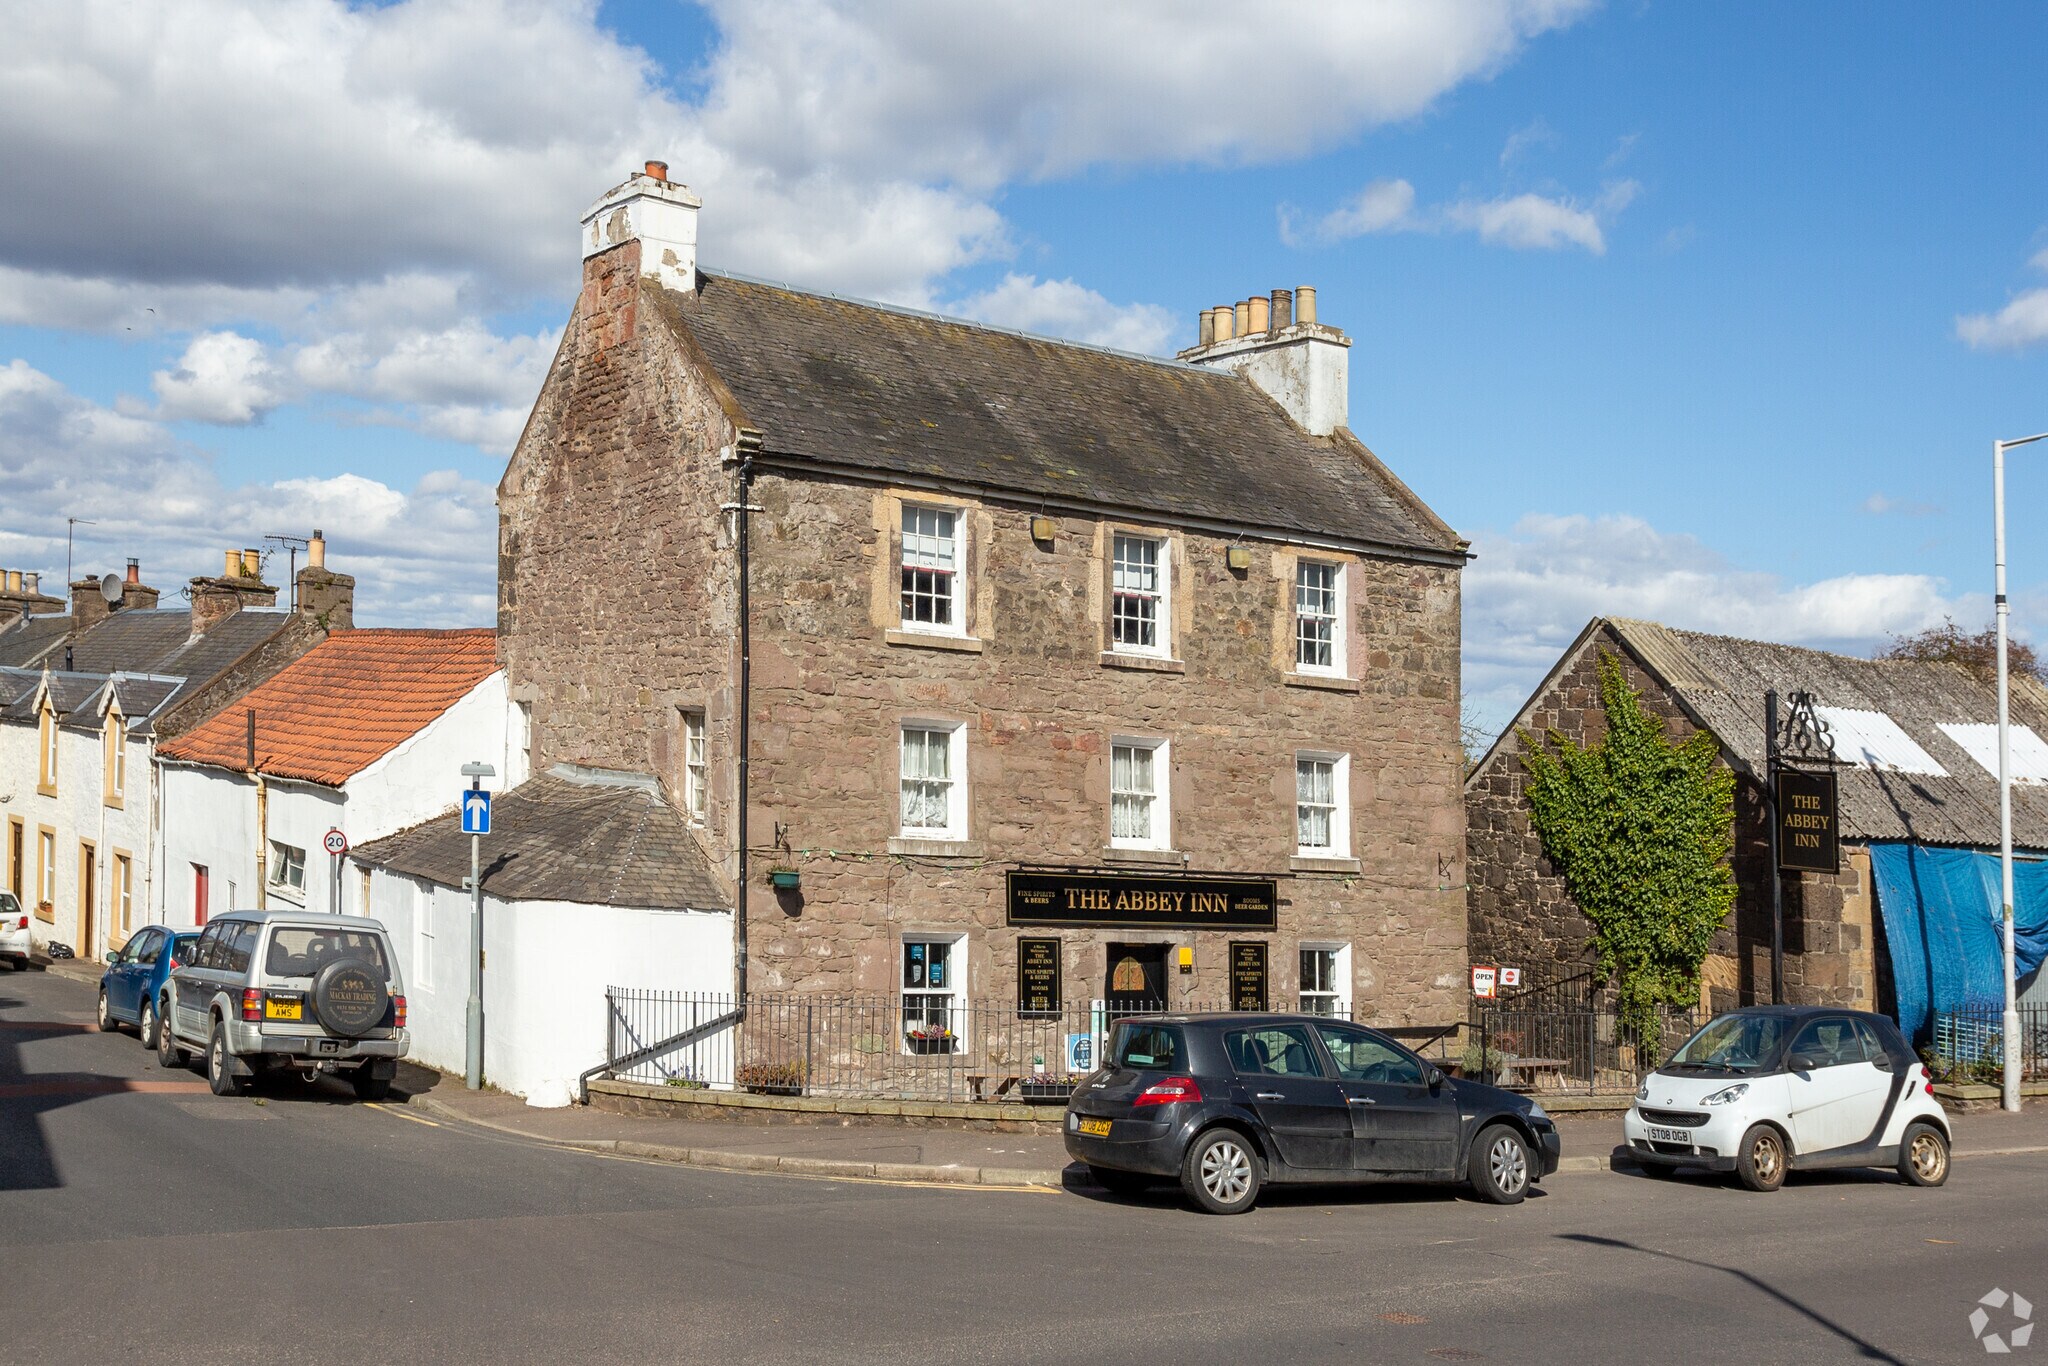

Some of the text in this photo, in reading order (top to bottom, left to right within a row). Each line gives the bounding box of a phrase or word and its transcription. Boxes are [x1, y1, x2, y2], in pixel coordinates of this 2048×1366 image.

[1792, 794, 1820, 810] THE
[1784, 813, 1830, 830] ABBEY
[328, 836, 344, 847] 20
[1794, 833, 1820, 848] INN
[1064, 888, 1229, 913] THE ABBEY INN
[330, 991, 376, 1001] MACKAY TRADING
[273, 999, 295, 1008] N956
[1651, 1129, 1688, 1141] ST08 OGB
